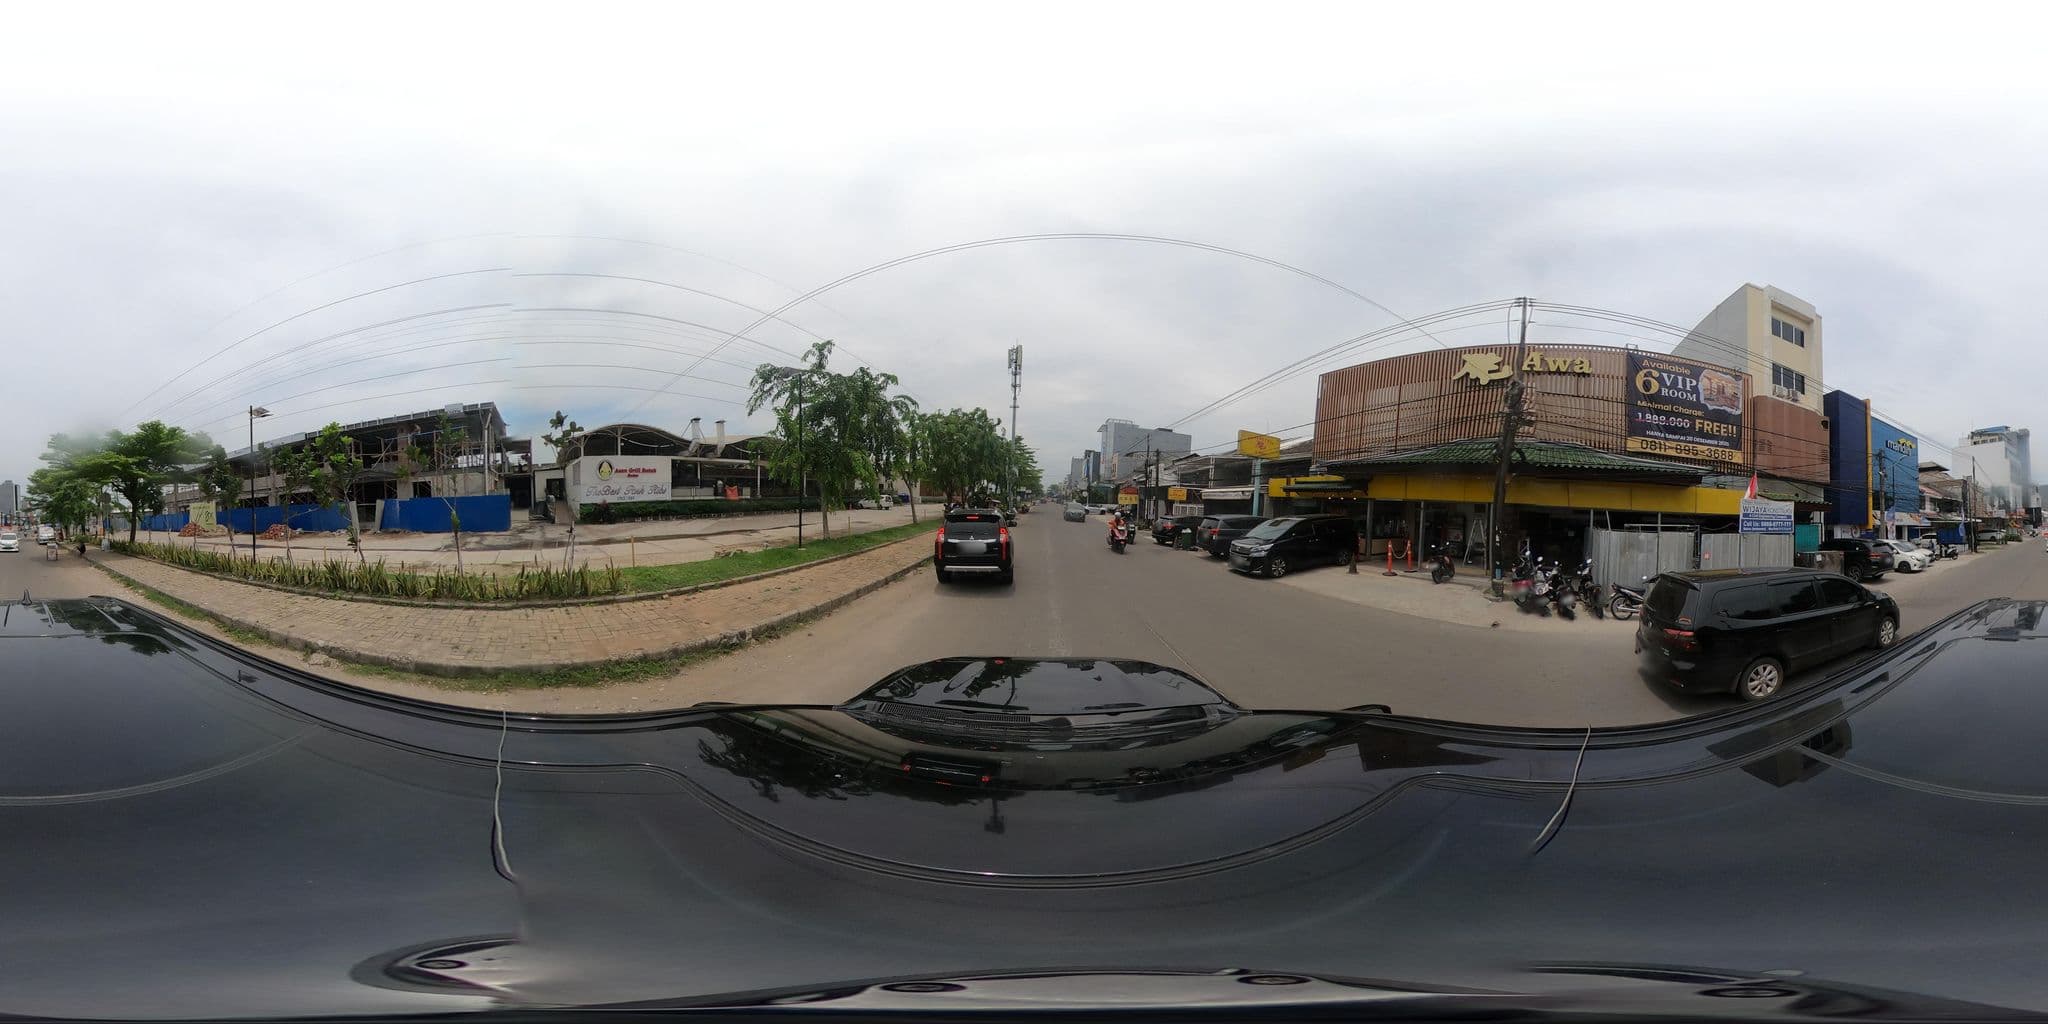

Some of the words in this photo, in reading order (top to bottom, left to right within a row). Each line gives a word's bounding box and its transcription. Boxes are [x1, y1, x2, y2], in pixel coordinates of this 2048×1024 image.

[1522, 351, 1593, 374] Awa
[1642, 359, 1691, 375] Available
[1635, 368, 1660, 395] 6
[1661, 372, 1697, 391] VIP
[1661, 388, 1697, 402] ROOM
[1637, 400, 1672, 412] Minimal
[1673, 405, 1705, 417] Charge:
[1695, 419, 1737, 437] FREE!!
[1646, 430, 1665, 438] HANYA
[1665, 433, 1686, 441] SAMPAI
[1694, 436, 1718, 445] DESEMBER
[1641, 439, 1734, 461] 0811-895-3688
[1886, 440, 1912, 456] mandiri
[600, 484, 620, 496] Best
[1743, 504, 1767, 513] WIJAYA
